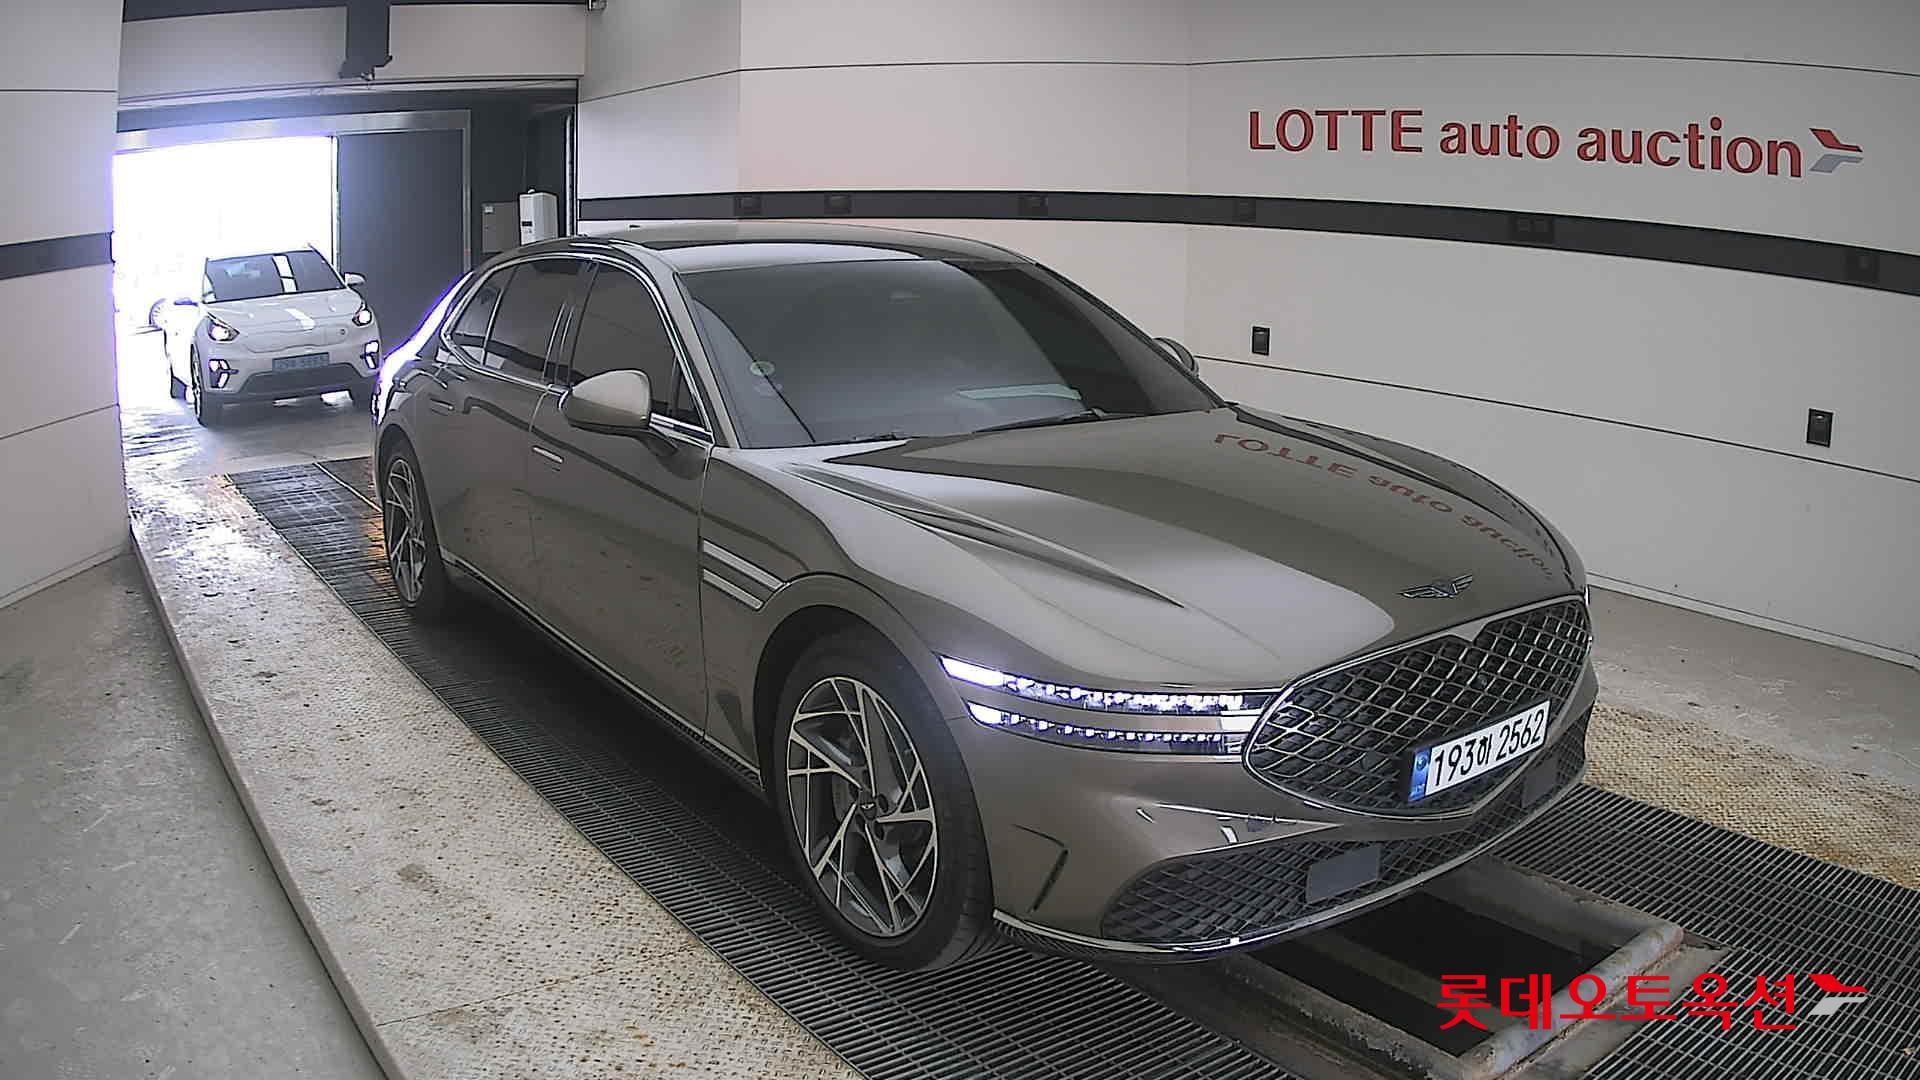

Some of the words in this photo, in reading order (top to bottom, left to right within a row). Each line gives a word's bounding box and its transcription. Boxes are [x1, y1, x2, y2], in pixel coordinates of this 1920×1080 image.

[1249, 109, 1424, 153] LOTTE
[1439, 114, 1560, 161] auto
[1577, 117, 1803, 177] auction
[1496, 709, 1545, 762] 2562
